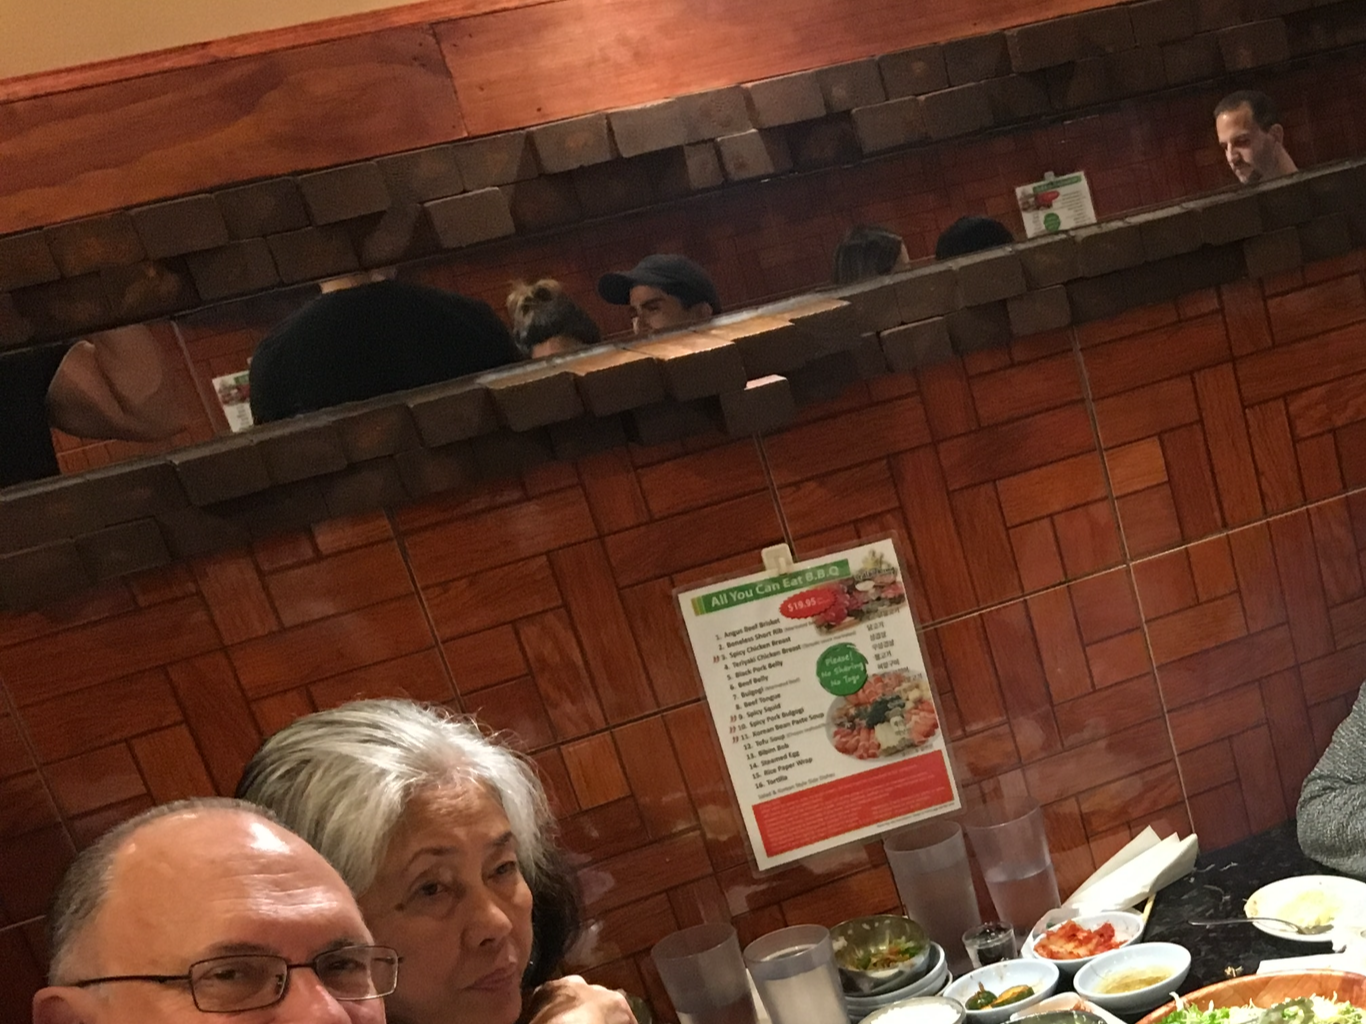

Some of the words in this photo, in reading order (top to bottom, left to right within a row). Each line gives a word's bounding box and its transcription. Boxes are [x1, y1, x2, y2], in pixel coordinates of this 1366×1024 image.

[709, 593, 728, 607] All
[729, 586, 753, 601] You
[755, 579, 780, 595] Can
[781, 574, 803, 588] Eat
[804, 564, 840, 583] B.B.Q
[787, 596, 816, 612] $19.95
[723, 627, 743, 639] Angus
[743, 623, 758, 632] Beef
[758, 617, 780, 628] Brisket
[726, 635, 754, 648] Boneless
[754, 631, 771, 640] Short
[772, 627, 783, 635] Rib
[729, 648, 746, 659] Spicy
[746, 641, 770, 653] Chicken
[771, 636, 791, 646] Breast
[731, 656, 756, 668] Teriyaki
[756, 649, 781, 661] Chicken
[781, 644, 801, 654] Breast
[824, 651, 853, 667] Please!
[734, 668, 751, 678] Black
[752, 664, 767, 673] Pork
[767, 659, 783, 669] Belly
[832, 660, 864, 678] Sharing
[737, 678, 753, 688] Beef
[752, 674, 769, 684] Belly
[829, 678, 841, 686] No
[842, 671, 861, 686] Togo
[740, 686, 764, 699] Bulgogi
[743, 698, 758, 708] Beef
[758, 692, 781, 704] Tongue
[737, 723, 747, 731] 10.
[749, 718, 766, 728] Spicy
[766, 713, 780, 722] Pork
[781, 706, 804, 719] Bulgogi
[746, 708, 762, 718] Spicy
[763, 702, 781, 713] Squid
[751, 725, 774, 737] Korean
[774, 720, 791, 730] Bean
[791, 716, 808, 725] Paste
[808, 711, 824, 721] Soup
[743, 742, 753, 750] 12.
[754, 737, 768, 747] Tofu
[769, 733, 785, 743] Soup
[746, 752, 756, 760] 13.
[776, 742, 789, 751] Bob
[749, 761, 759, 769] 14.
[760, 753, 787, 766] Steamed
[788, 749, 800, 759] Egg
[751, 771, 761, 779] 15.
[763, 767, 776, 776] Rice
[777, 761, 795, 772] Paper
[795, 756, 813, 767] Wrap
[754, 781, 765, 789] 16.
[766, 774, 788, 785] Tortilla
[795, 780, 807, 788] Style
[808, 776, 819, 784] Side
